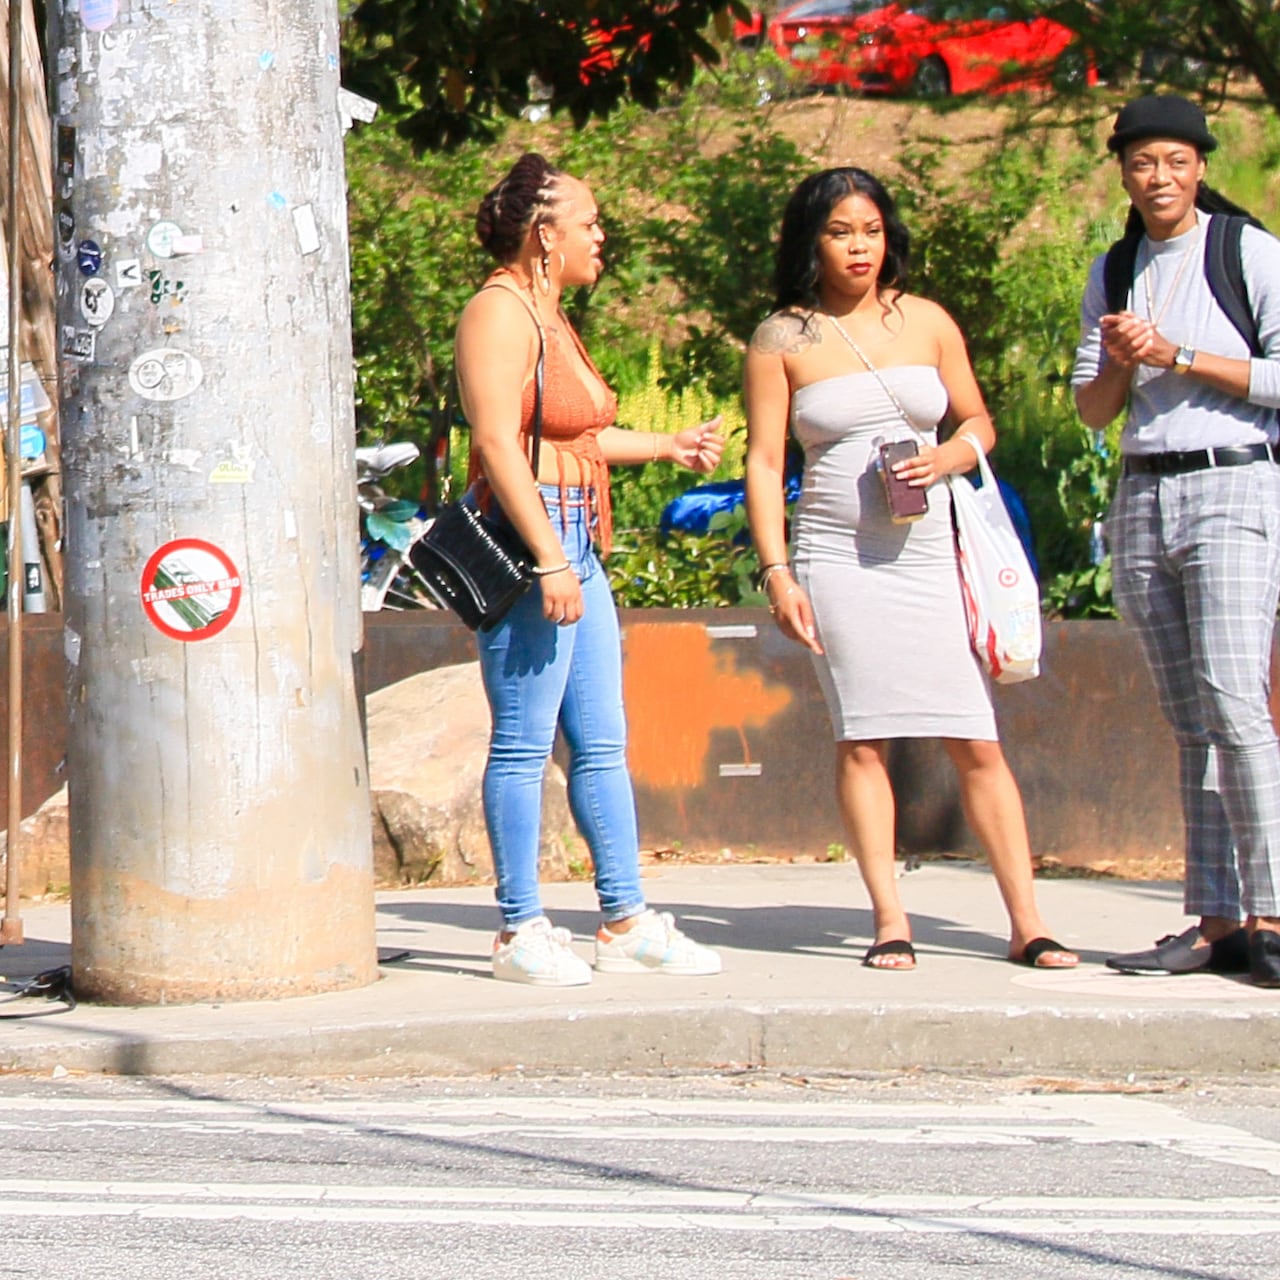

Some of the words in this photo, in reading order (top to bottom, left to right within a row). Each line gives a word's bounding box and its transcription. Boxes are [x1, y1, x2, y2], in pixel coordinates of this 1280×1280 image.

[143, 586, 185, 603] TRADES
[186, 581, 216, 595] ONLY
[217, 577, 240, 591] BRO
